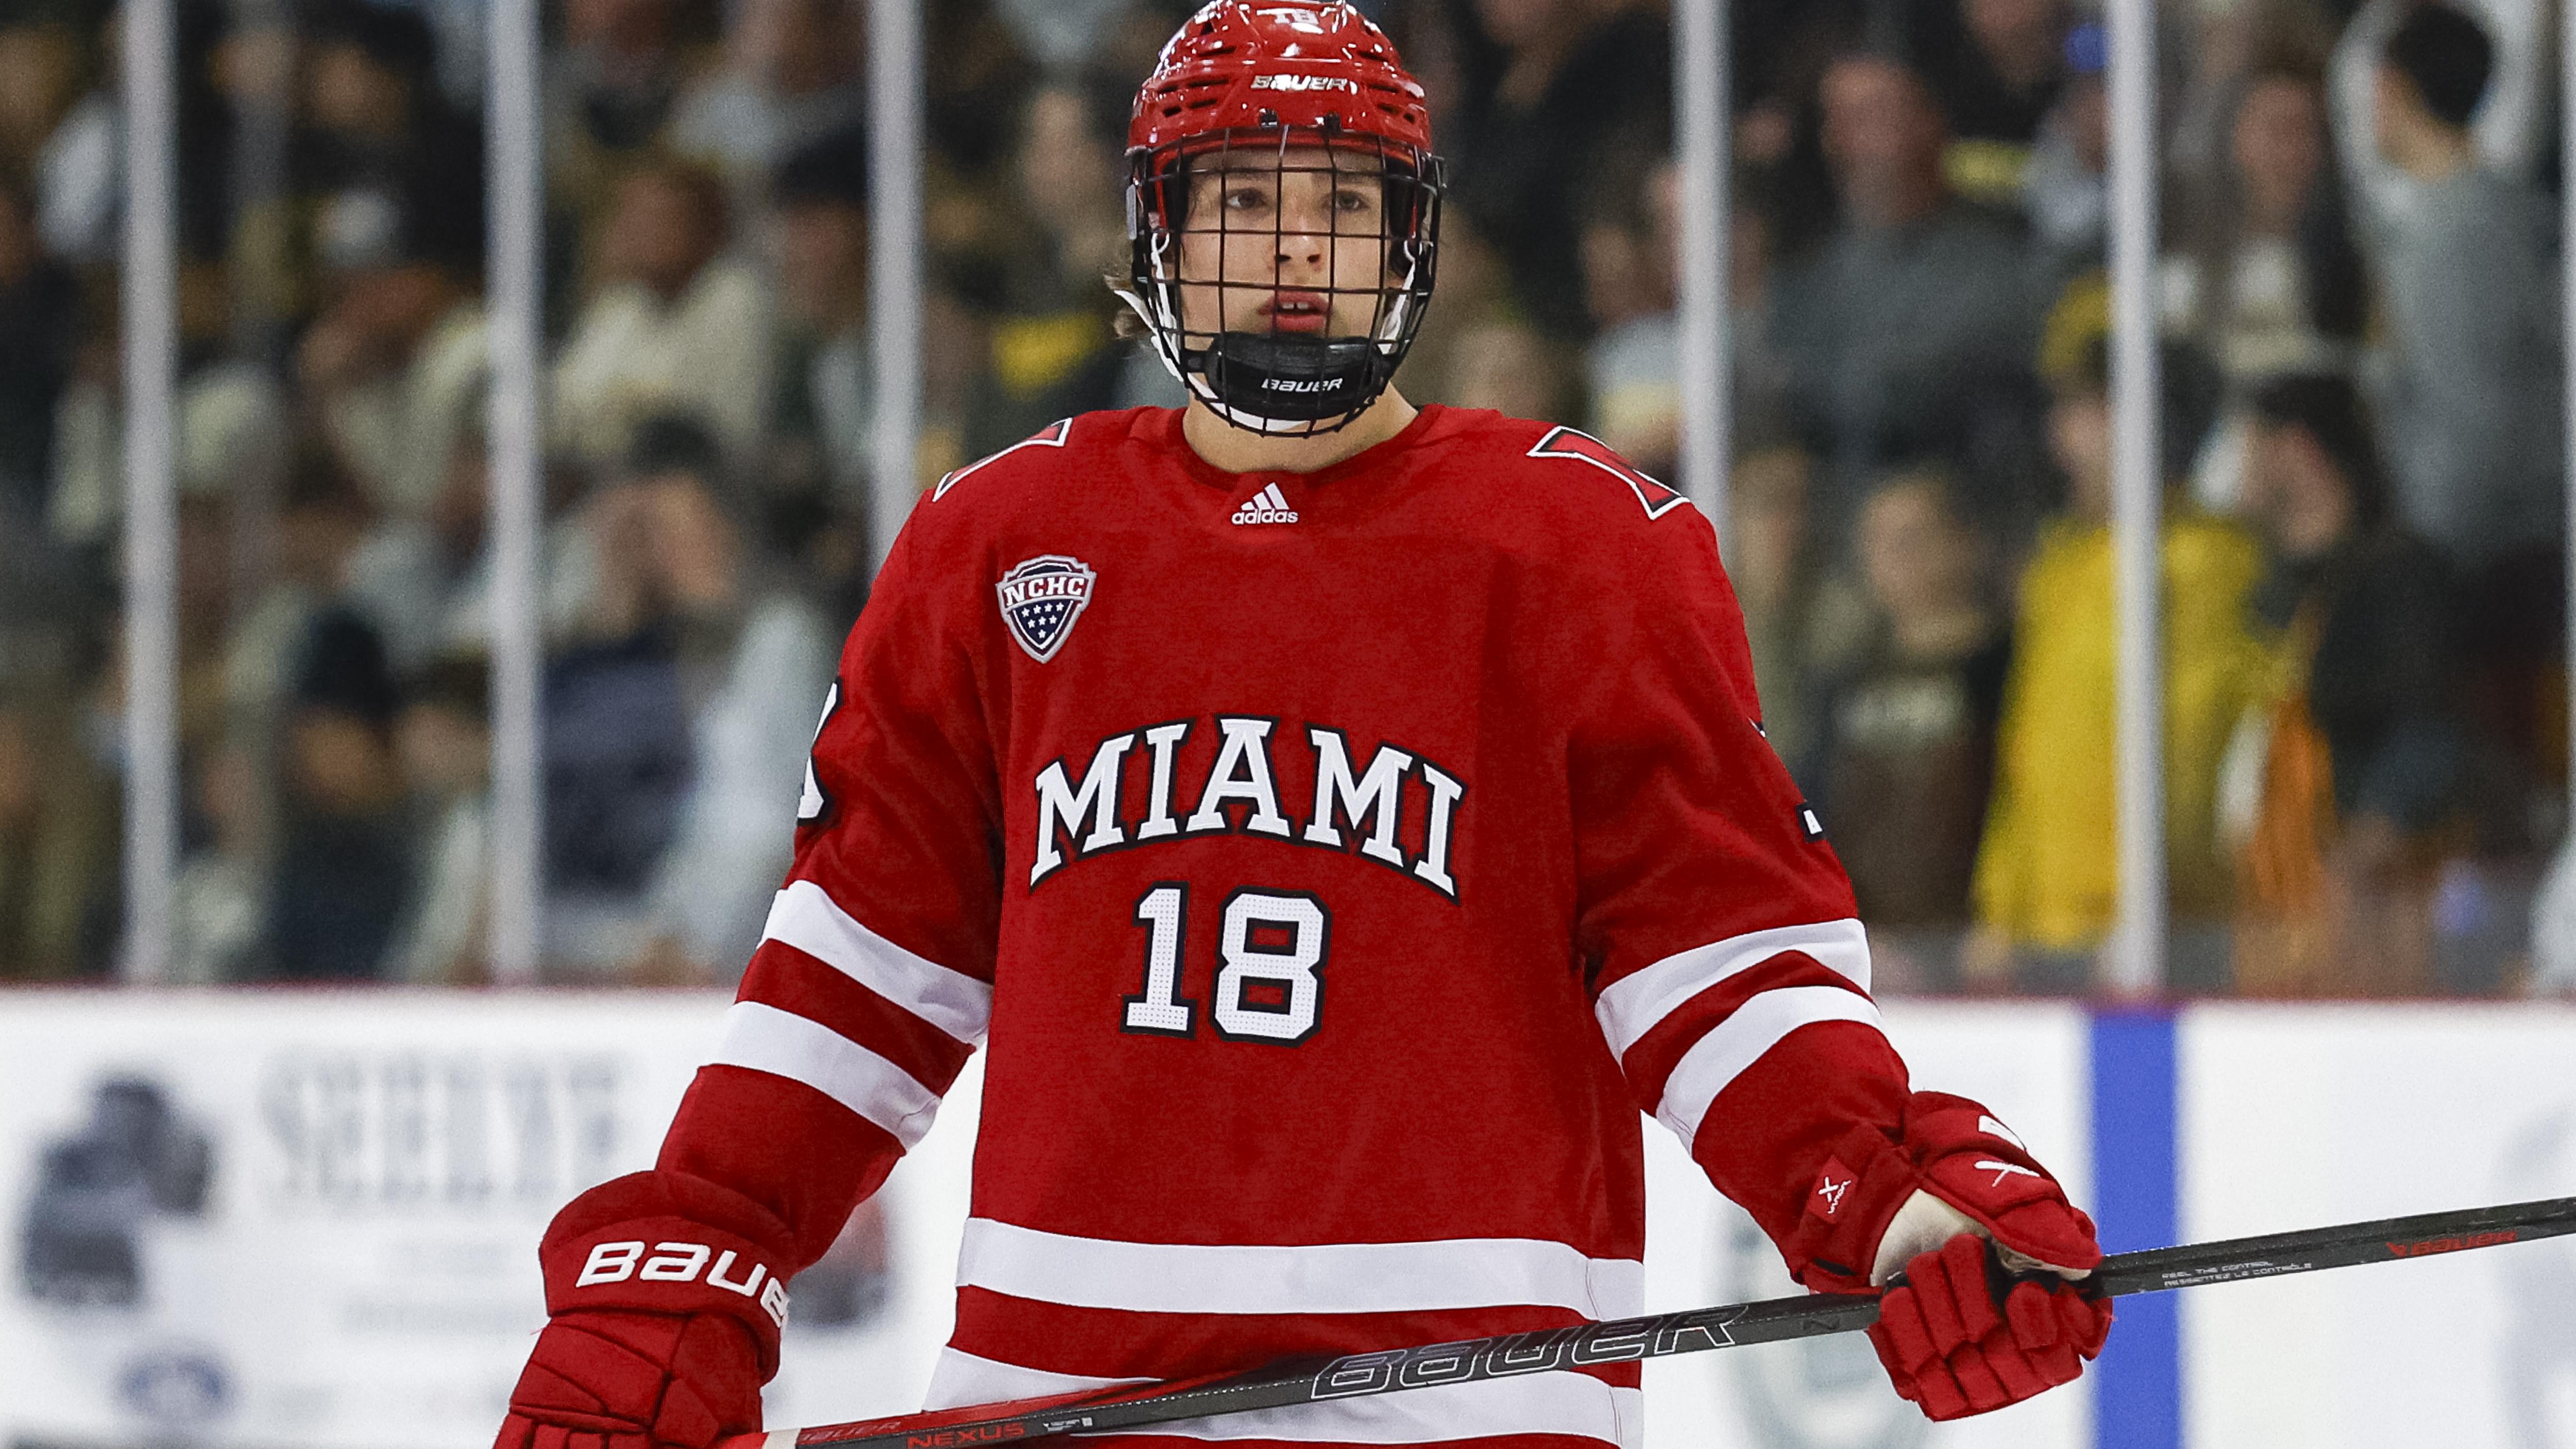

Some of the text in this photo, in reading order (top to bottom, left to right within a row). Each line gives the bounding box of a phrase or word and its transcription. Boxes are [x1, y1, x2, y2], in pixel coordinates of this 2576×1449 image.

[1250, 74, 1348, 91] BAUER
[1261, 378, 1343, 392] BAUER
[1231, 508, 1299, 525] adidas
[1004, 576, 1084, 606] NCHC
[1029, 716, 1464, 901] MIAMI
[1124, 885, 1328, 1043] 18
[2410, 1230, 2518, 1256] BAUER
[575, 1241, 789, 1328] BAUE
[1311, 1304, 1749, 1399] BAUER
[907, 1422, 1026, 1448] NEXUS
